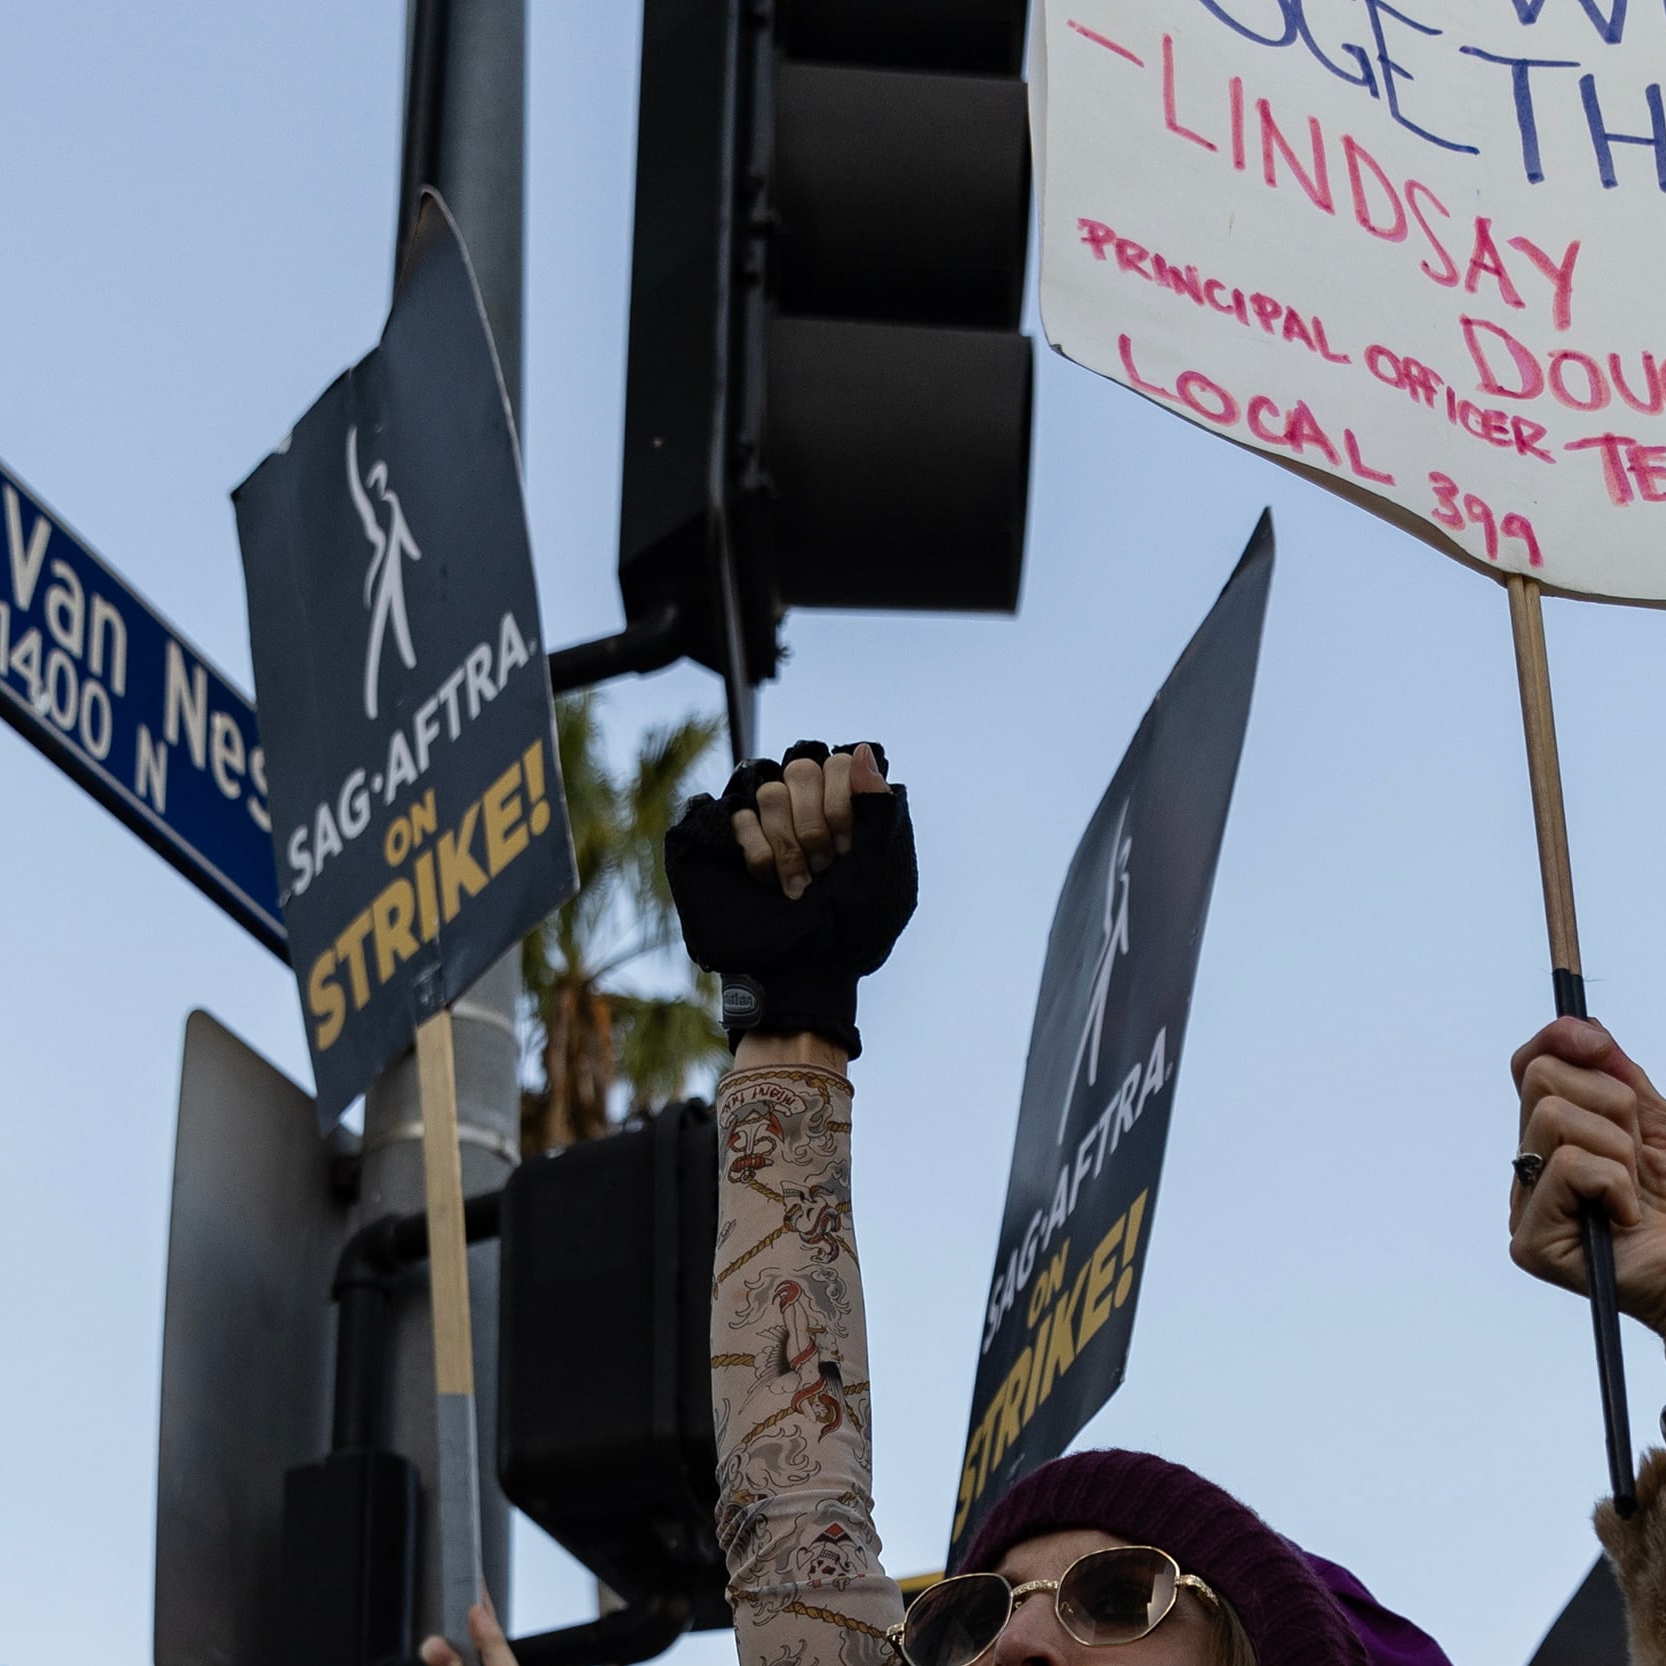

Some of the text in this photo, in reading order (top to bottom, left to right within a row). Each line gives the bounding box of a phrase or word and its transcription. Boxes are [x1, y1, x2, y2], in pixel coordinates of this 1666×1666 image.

[1077, 217, 1353, 365] PRINCIPAL
[1363, 343, 1557, 466] OFFICER
[1117, 332, 1545, 569] LOCAL 399
[1, 482, 128, 700] Van
[135, 723, 170, 816] N
[384, 788, 438, 868] ON
[306, 737, 553, 1053] STRIKE!
[951, 1184, 1151, 1546] STRIKE!
[1026, 1236, 1071, 1330] ON
